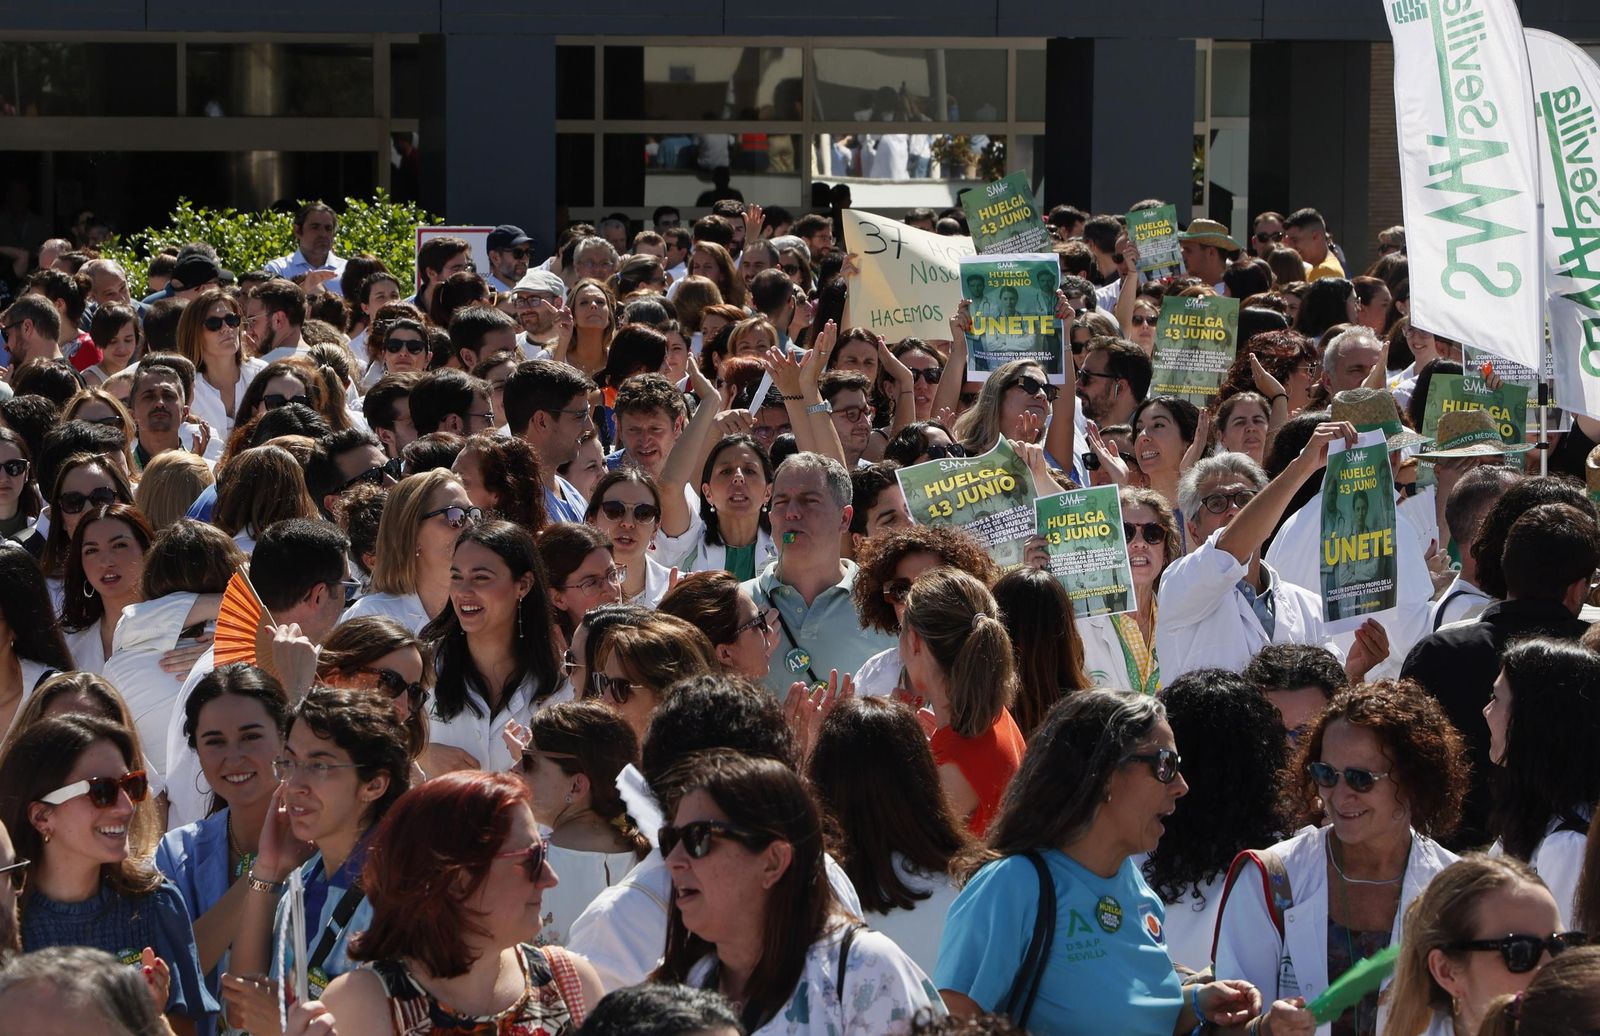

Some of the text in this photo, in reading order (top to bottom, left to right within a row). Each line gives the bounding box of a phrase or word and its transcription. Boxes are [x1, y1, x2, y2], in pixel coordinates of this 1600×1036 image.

[978, 194, 1025, 220] HUELGA
[981, 207, 1031, 234] 13 JUNIO
[1136, 220, 1169, 232] HUELGA
[859, 221, 909, 259] 37
[1147, 227, 1172, 238] JUNIO
[871, 304, 943, 328] HACEMOS
[971, 311, 1055, 336] ÚNETE
[1169, 314, 1223, 328] HUELGA
[1165, 328, 1226, 340] 13 JUNIO
[1463, 379, 1491, 394] SMA
[1346, 452, 1365, 462] SMA
[940, 461, 970, 470] SMA
[1340, 465, 1376, 480] HUELGA
[924, 468, 1009, 498] HUELGA
[1339, 477, 1377, 494] 13 JUNIO
[928, 476, 1016, 518] 13 JUNIO
[1060, 494, 1080, 506] SMA
[990, 508, 1014, 521] TODOS
[1014, 504, 1028, 513] LOS
[1047, 510, 1106, 529] HUELGA
[1005, 516, 1031, 529] HUELGA
[990, 526, 1020, 540] DEFENSA
[1013, 527, 1036, 540] DIGNID
[1046, 524, 1110, 544] 13 JUNIO
[1324, 528, 1393, 566] ÚNETE
[1344, 584, 1366, 592] ESTATUTO
[1066, 950, 1108, 962] SEVILLA
